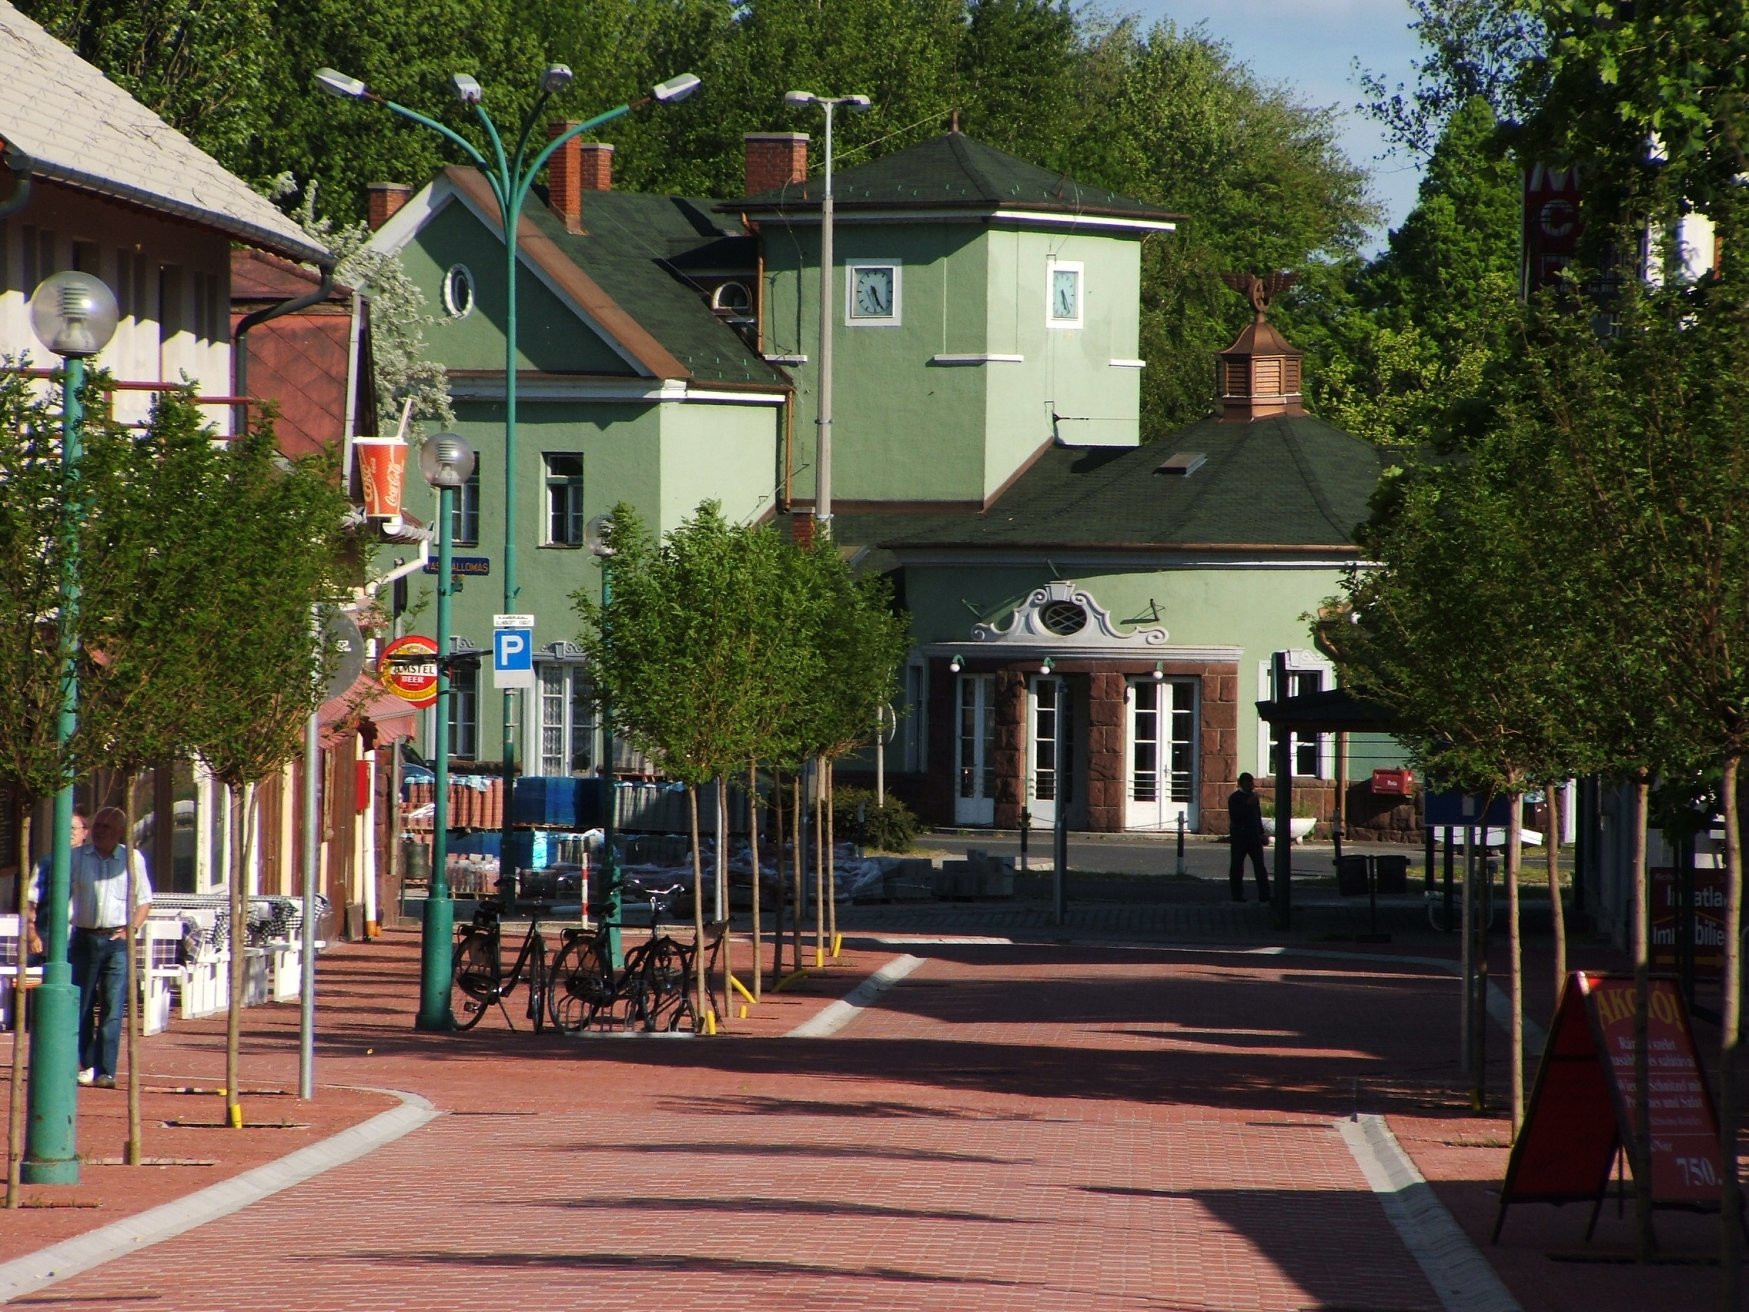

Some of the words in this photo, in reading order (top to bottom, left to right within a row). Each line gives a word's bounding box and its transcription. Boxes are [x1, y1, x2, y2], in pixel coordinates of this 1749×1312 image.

[501, 635, 524, 666] P
[393, 664, 435, 675] AMSTEL
[401, 676, 425, 684] BEER
